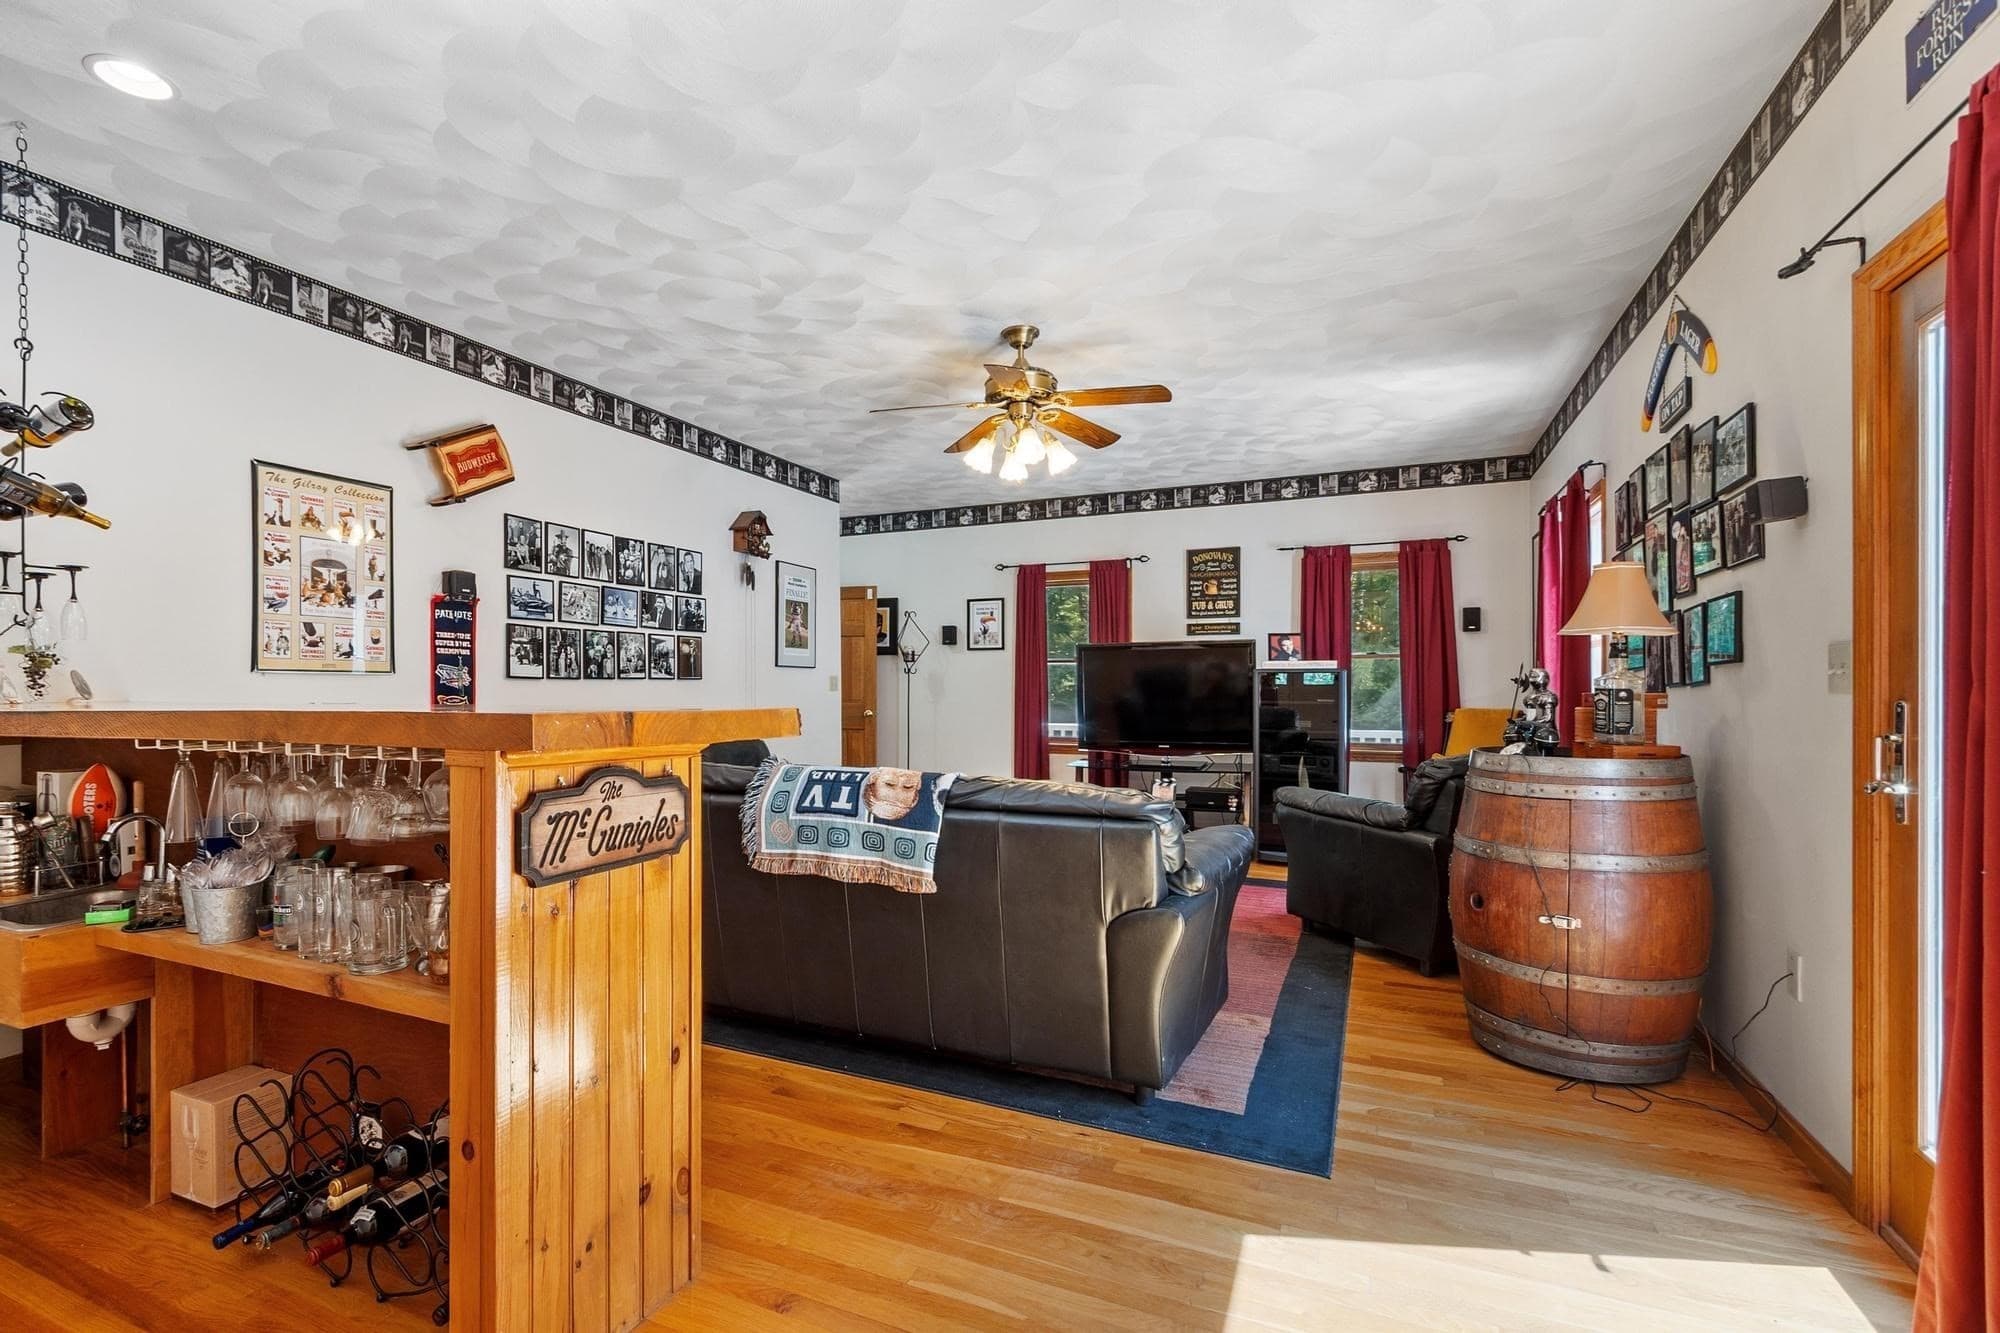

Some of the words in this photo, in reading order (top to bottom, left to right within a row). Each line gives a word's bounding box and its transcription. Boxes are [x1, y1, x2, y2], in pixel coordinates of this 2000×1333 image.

[1931, 0, 1961, 31] RU
[1916, 0, 1980, 68] FORRES
[1932, 22, 1964, 71] RUN
[1679, 320, 1701, 355] LAGER
[1661, 403, 1671, 422] ON
[1671, 390, 1683, 413] TAP
[456, 452, 499, 474] BUDWEISER
[265, 471, 288, 484] The
[292, 478, 328, 494] Gilroy
[334, 485, 385, 502] Collection
[1192, 551, 1234, 564] DONOVAN'S
[435, 609, 473, 621] PATRIOTS
[1192, 601, 1206, 610] PUB
[1207, 601, 1214, 610] &
[1215, 600, 1234, 609] GRUB
[83, 782, 97, 824] OTERS
[600, 780, 623, 803] The
[801, 784, 853, 810] TV
[539, 797, 679, 869] McGunigles
